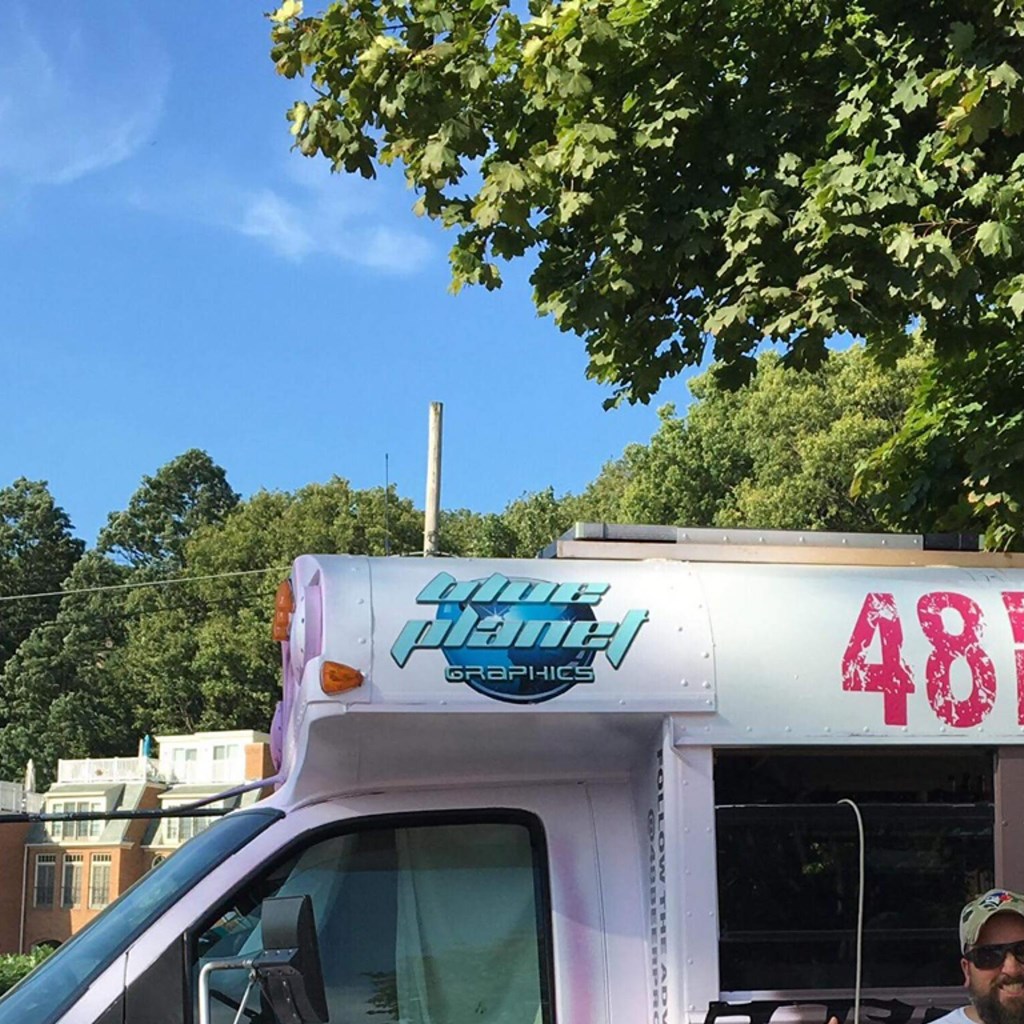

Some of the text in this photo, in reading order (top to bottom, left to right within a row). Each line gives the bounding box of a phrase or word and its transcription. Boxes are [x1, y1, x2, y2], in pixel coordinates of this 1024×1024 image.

[444, 664, 595, 684] GRAPHICS
[841, 591, 997, 728] 48
[656, 749, 666, 883] FOLLOW
